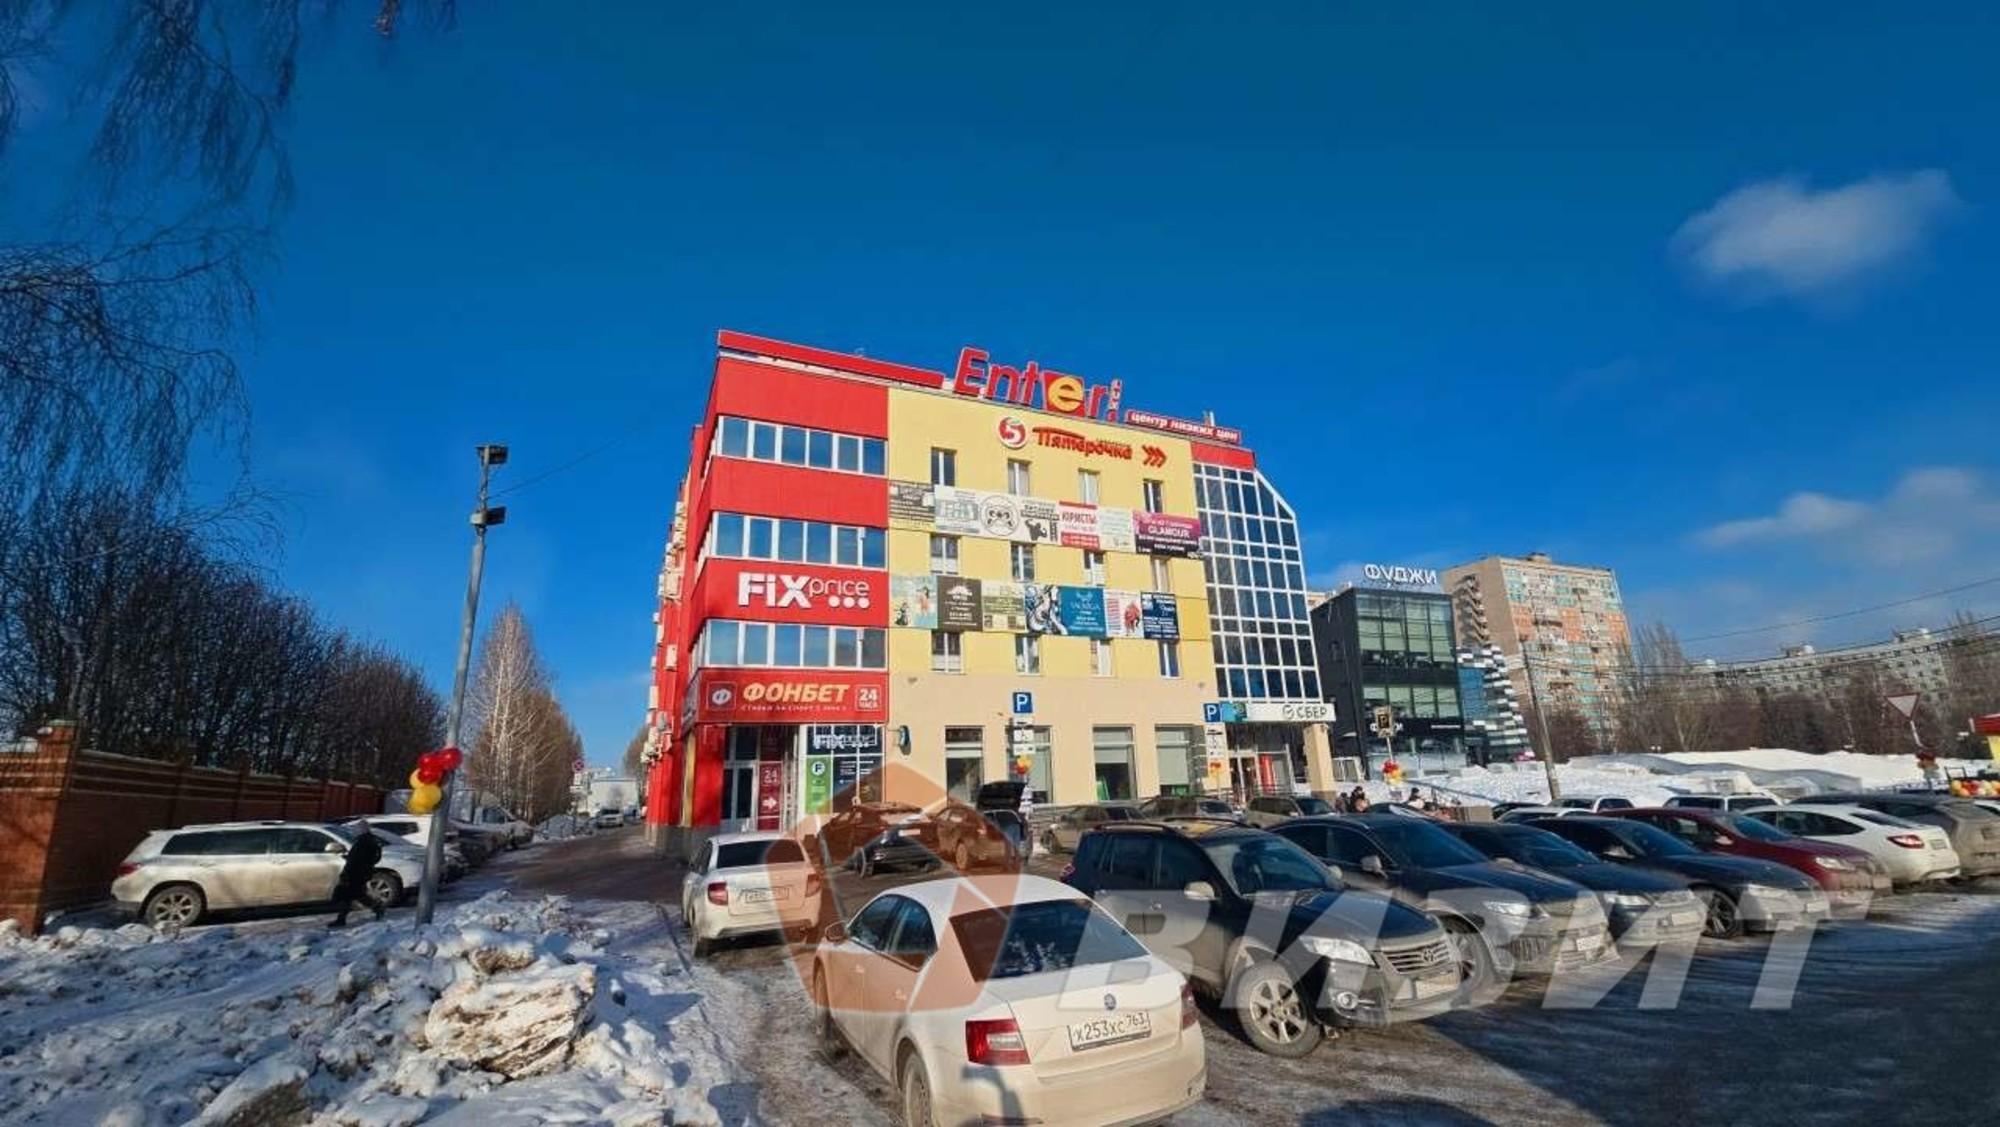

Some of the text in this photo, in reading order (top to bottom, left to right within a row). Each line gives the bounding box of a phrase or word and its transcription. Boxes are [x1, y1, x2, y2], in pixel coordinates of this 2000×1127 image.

[1131, 412, 1168, 428] центр
[1062, 511, 1097, 524] ЮРИСТЫ
[1363, 563, 1437, 588] ФУДЖИ
[808, 577, 871, 598] price
[742, 681, 851, 703] ФОНБЕТ
[859, 687, 878, 701] 24
[1016, 694, 1028, 712] P
[1206, 705, 1217, 721] P
[1297, 706, 1327, 719] СБЕР
